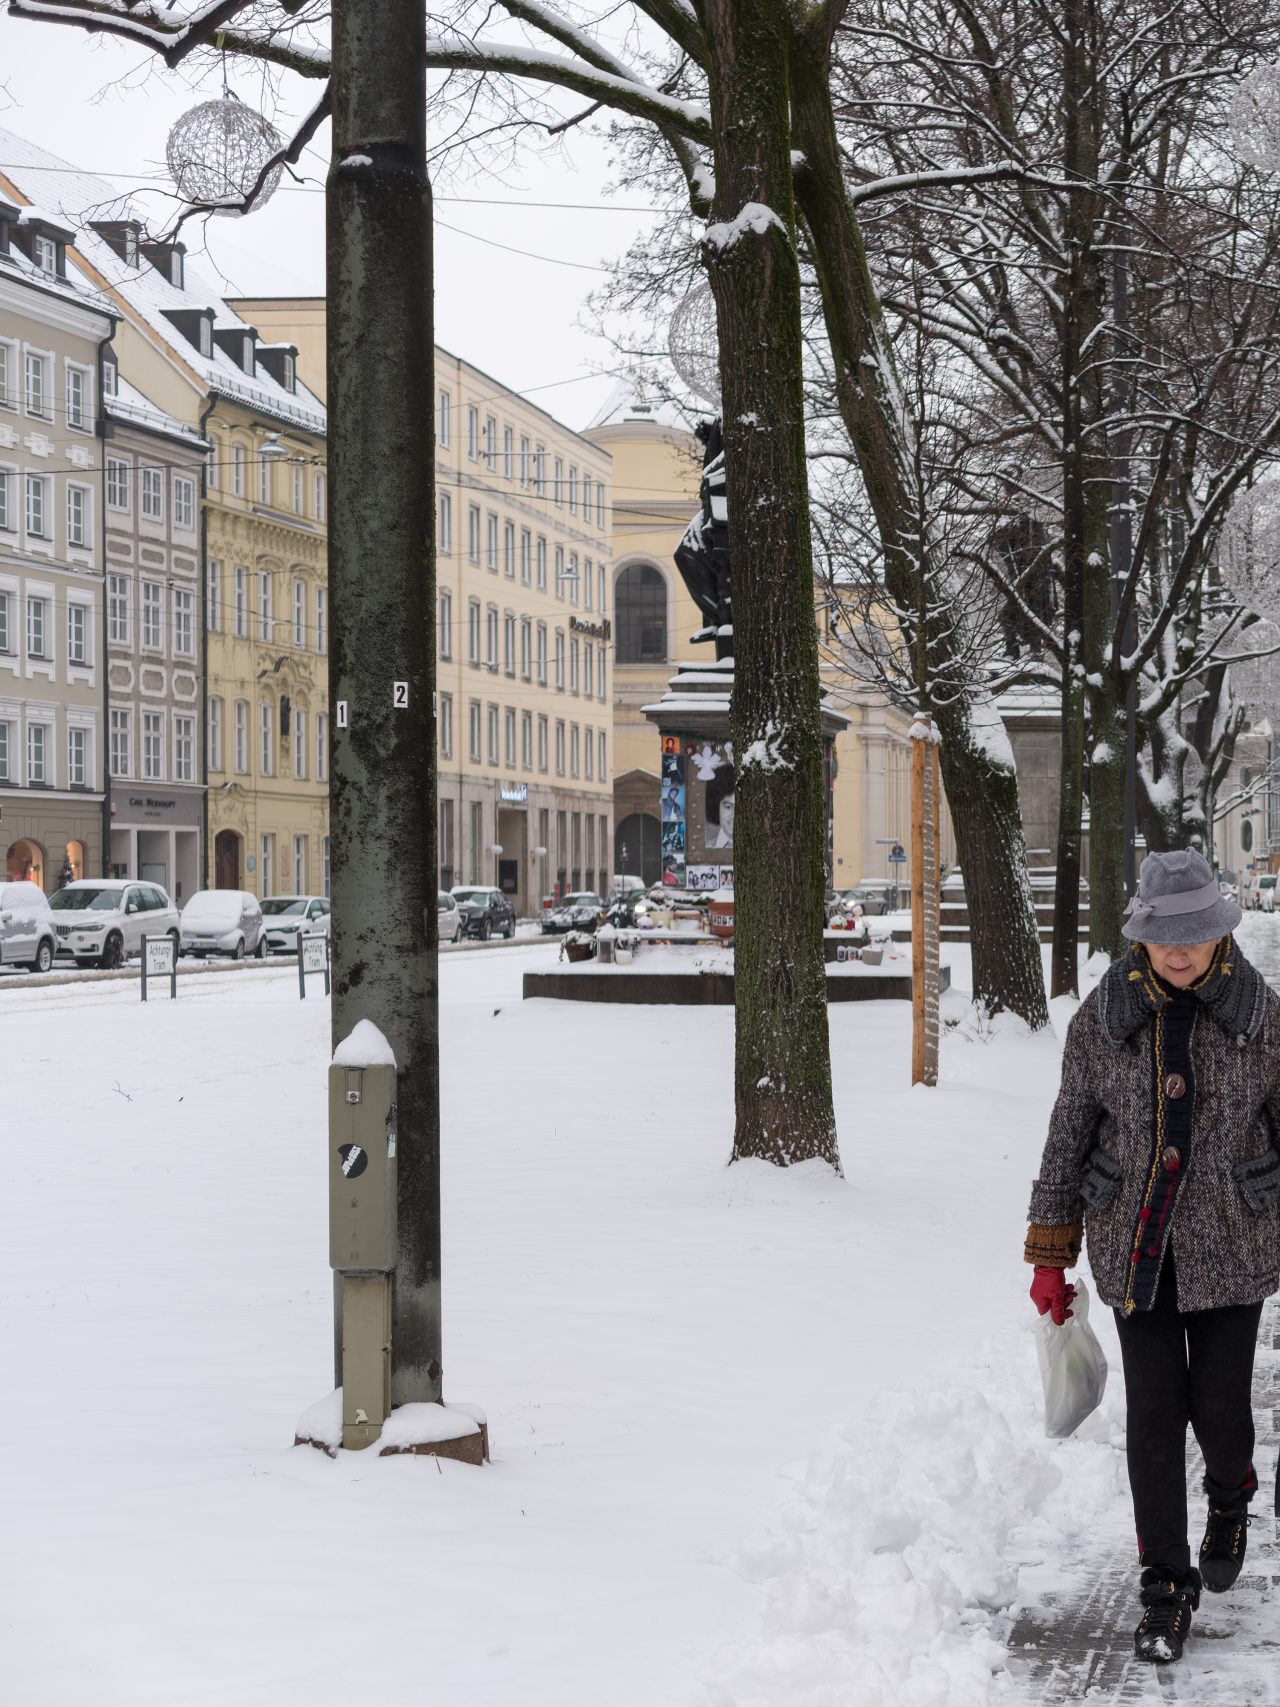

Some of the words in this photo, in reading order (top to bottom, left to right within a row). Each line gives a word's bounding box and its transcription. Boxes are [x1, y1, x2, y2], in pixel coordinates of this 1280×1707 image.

[396, 685, 406, 704] 2
[339, 704, 345, 723] 1
[153, 958, 166, 971] Tram
[308, 956, 321, 968] Tram
